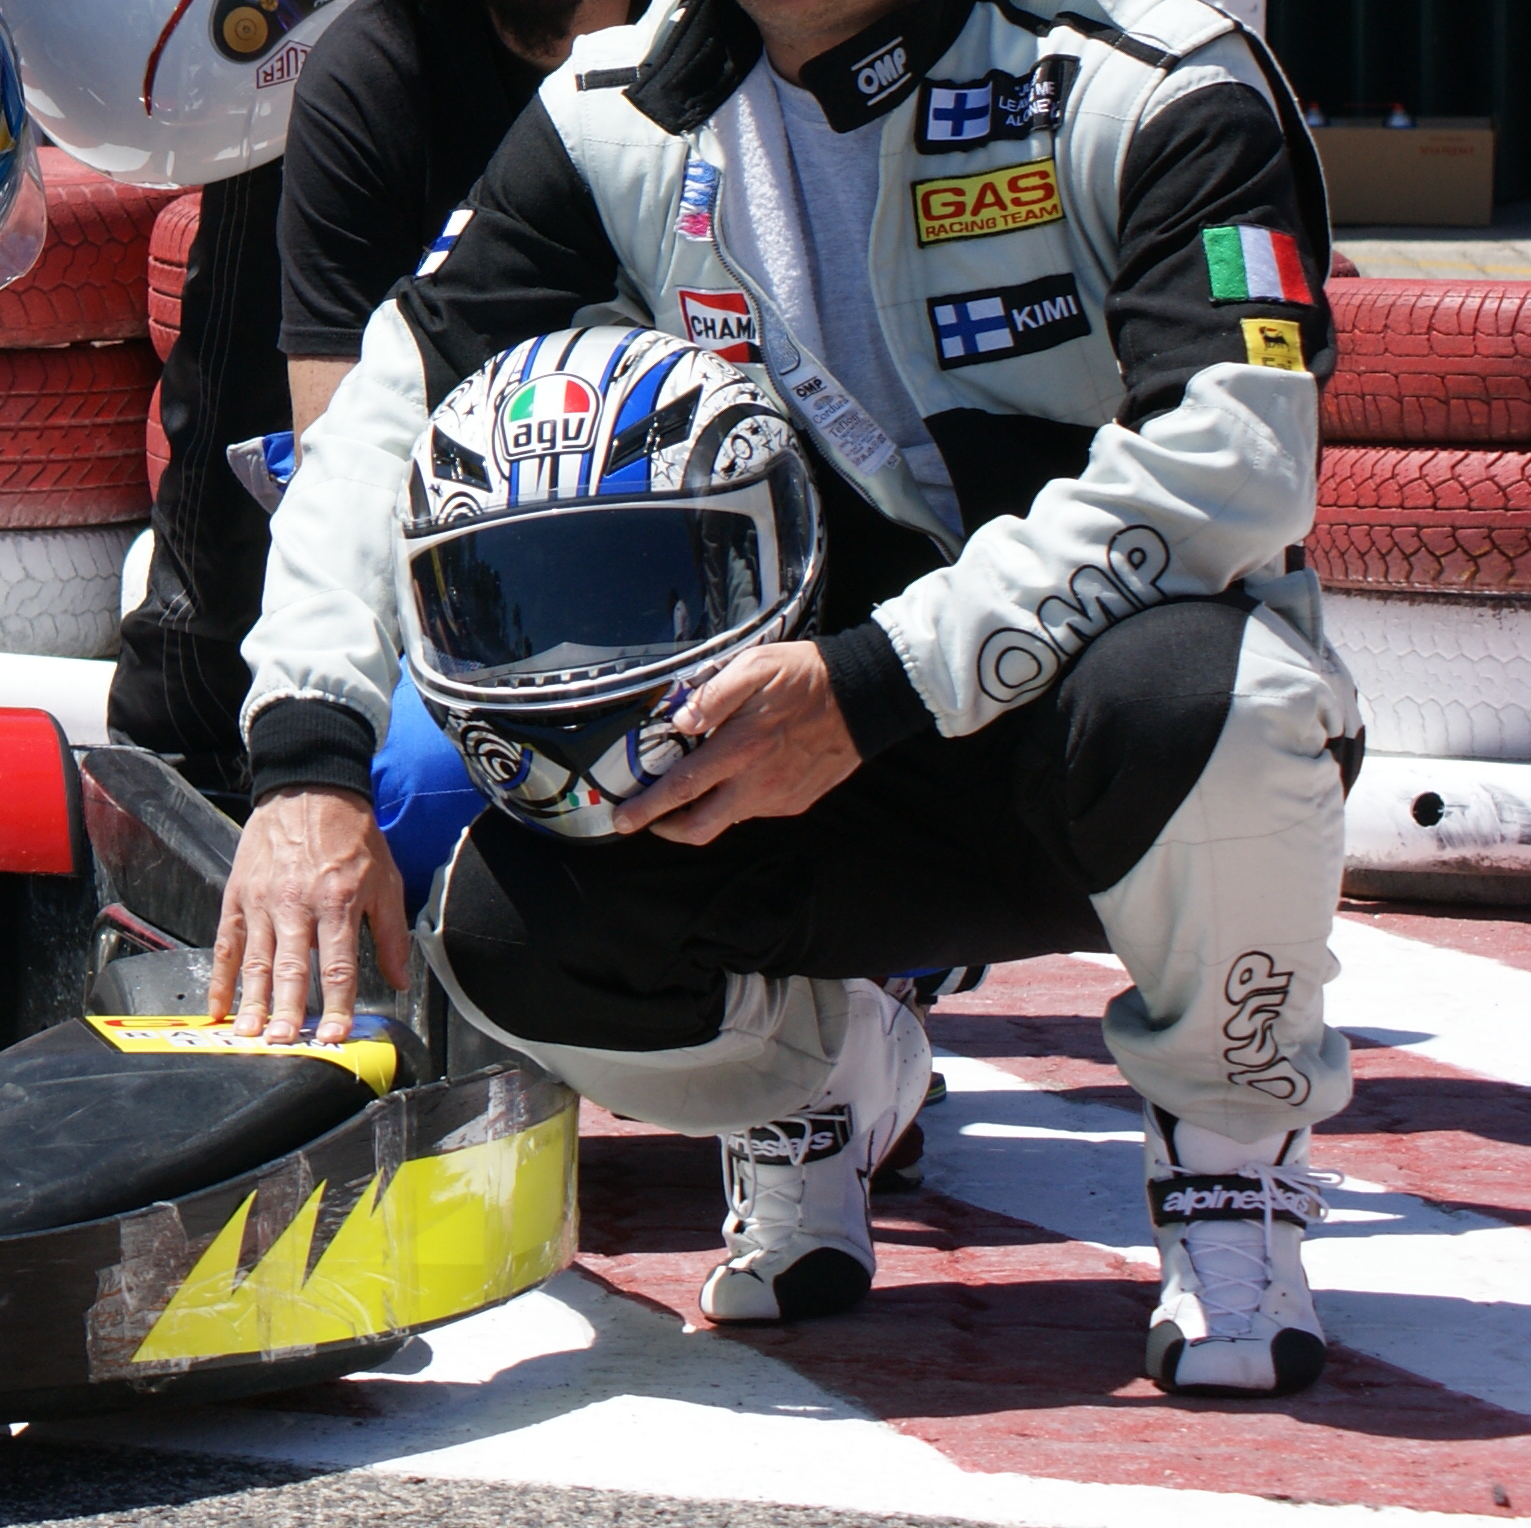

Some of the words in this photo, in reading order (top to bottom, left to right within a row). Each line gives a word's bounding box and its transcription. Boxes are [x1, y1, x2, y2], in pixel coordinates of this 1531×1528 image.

[857, 47, 907, 94] OMP
[920, 168, 1055, 222] GAS
[925, 216, 997, 239] RACING
[999, 203, 1059, 227] TEAM
[1012, 294, 1078, 332] KIMI
[795, 378, 823, 398] OMP
[512, 417, 585, 452] agv
[978, 524, 1171, 704] OMP
